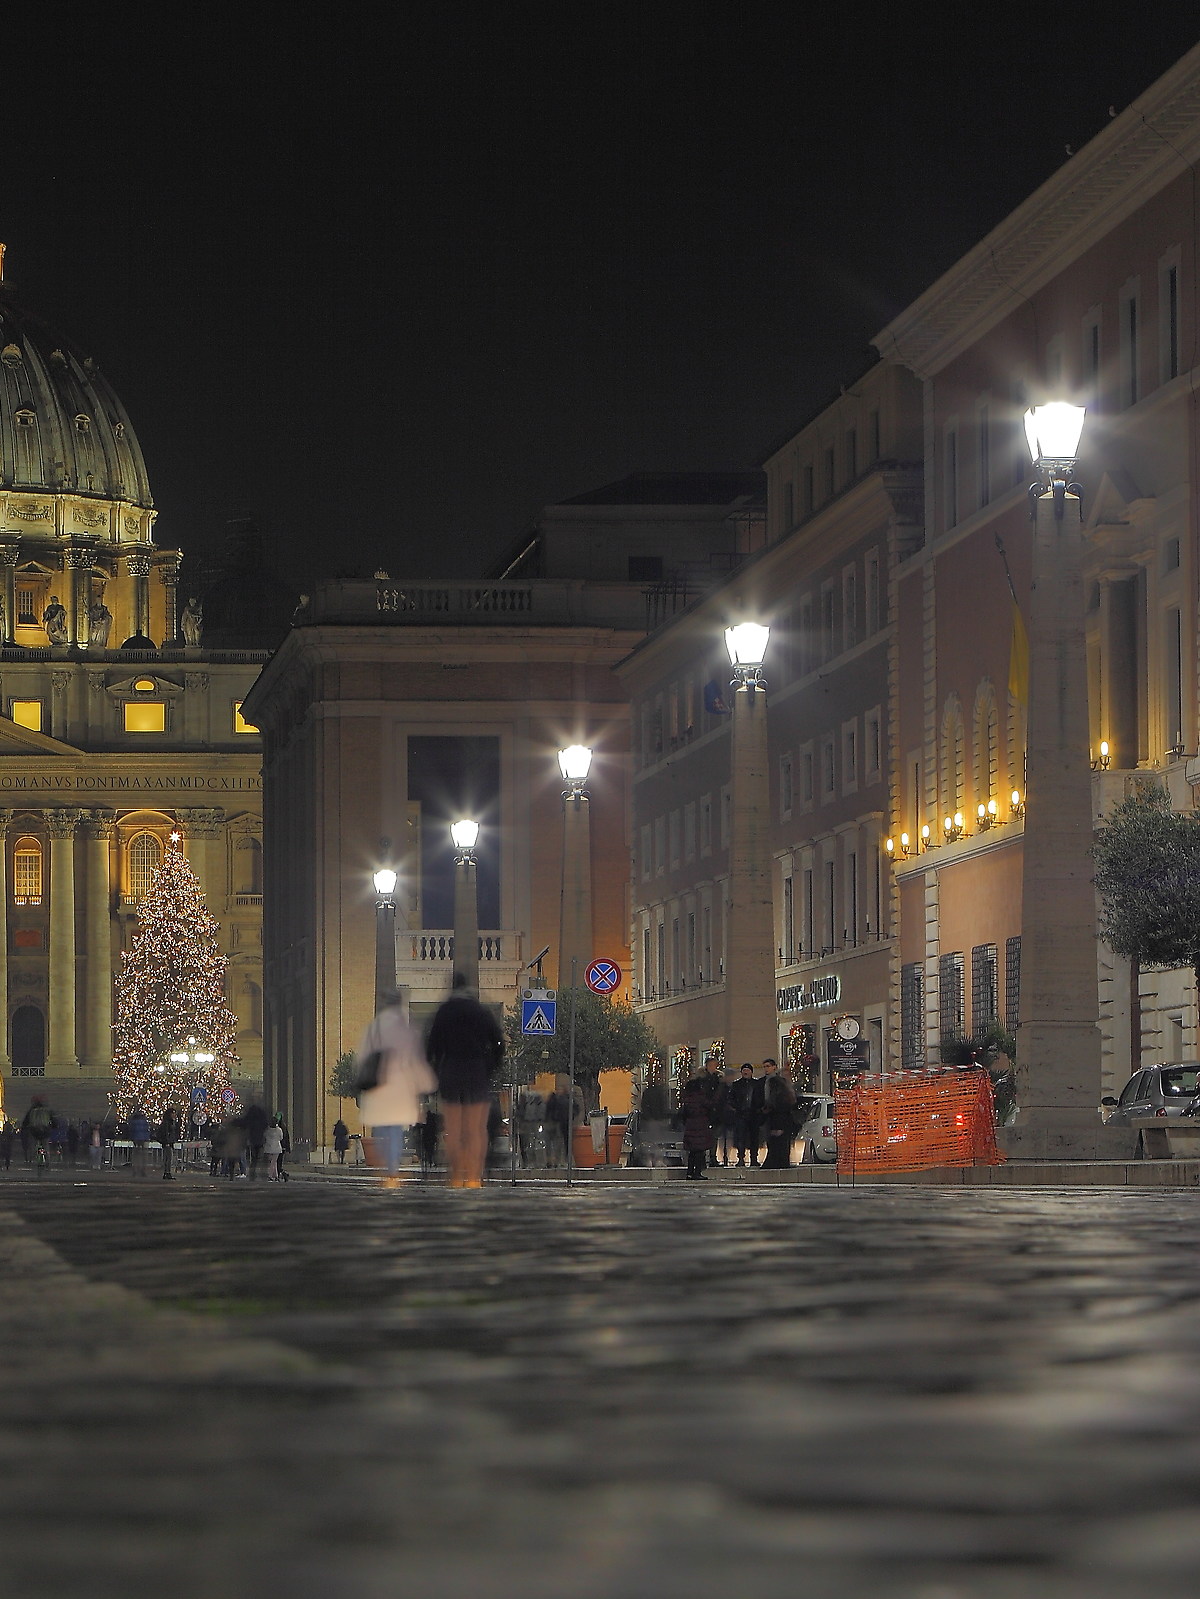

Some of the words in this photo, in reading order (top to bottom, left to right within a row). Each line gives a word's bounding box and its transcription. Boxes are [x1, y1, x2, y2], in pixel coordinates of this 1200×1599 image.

[75, 776, 116, 788] PONT
[118, 776, 152, 788] MAX
[154, 776, 177, 788] AN
[179, 776, 243, 789] MDCXII
